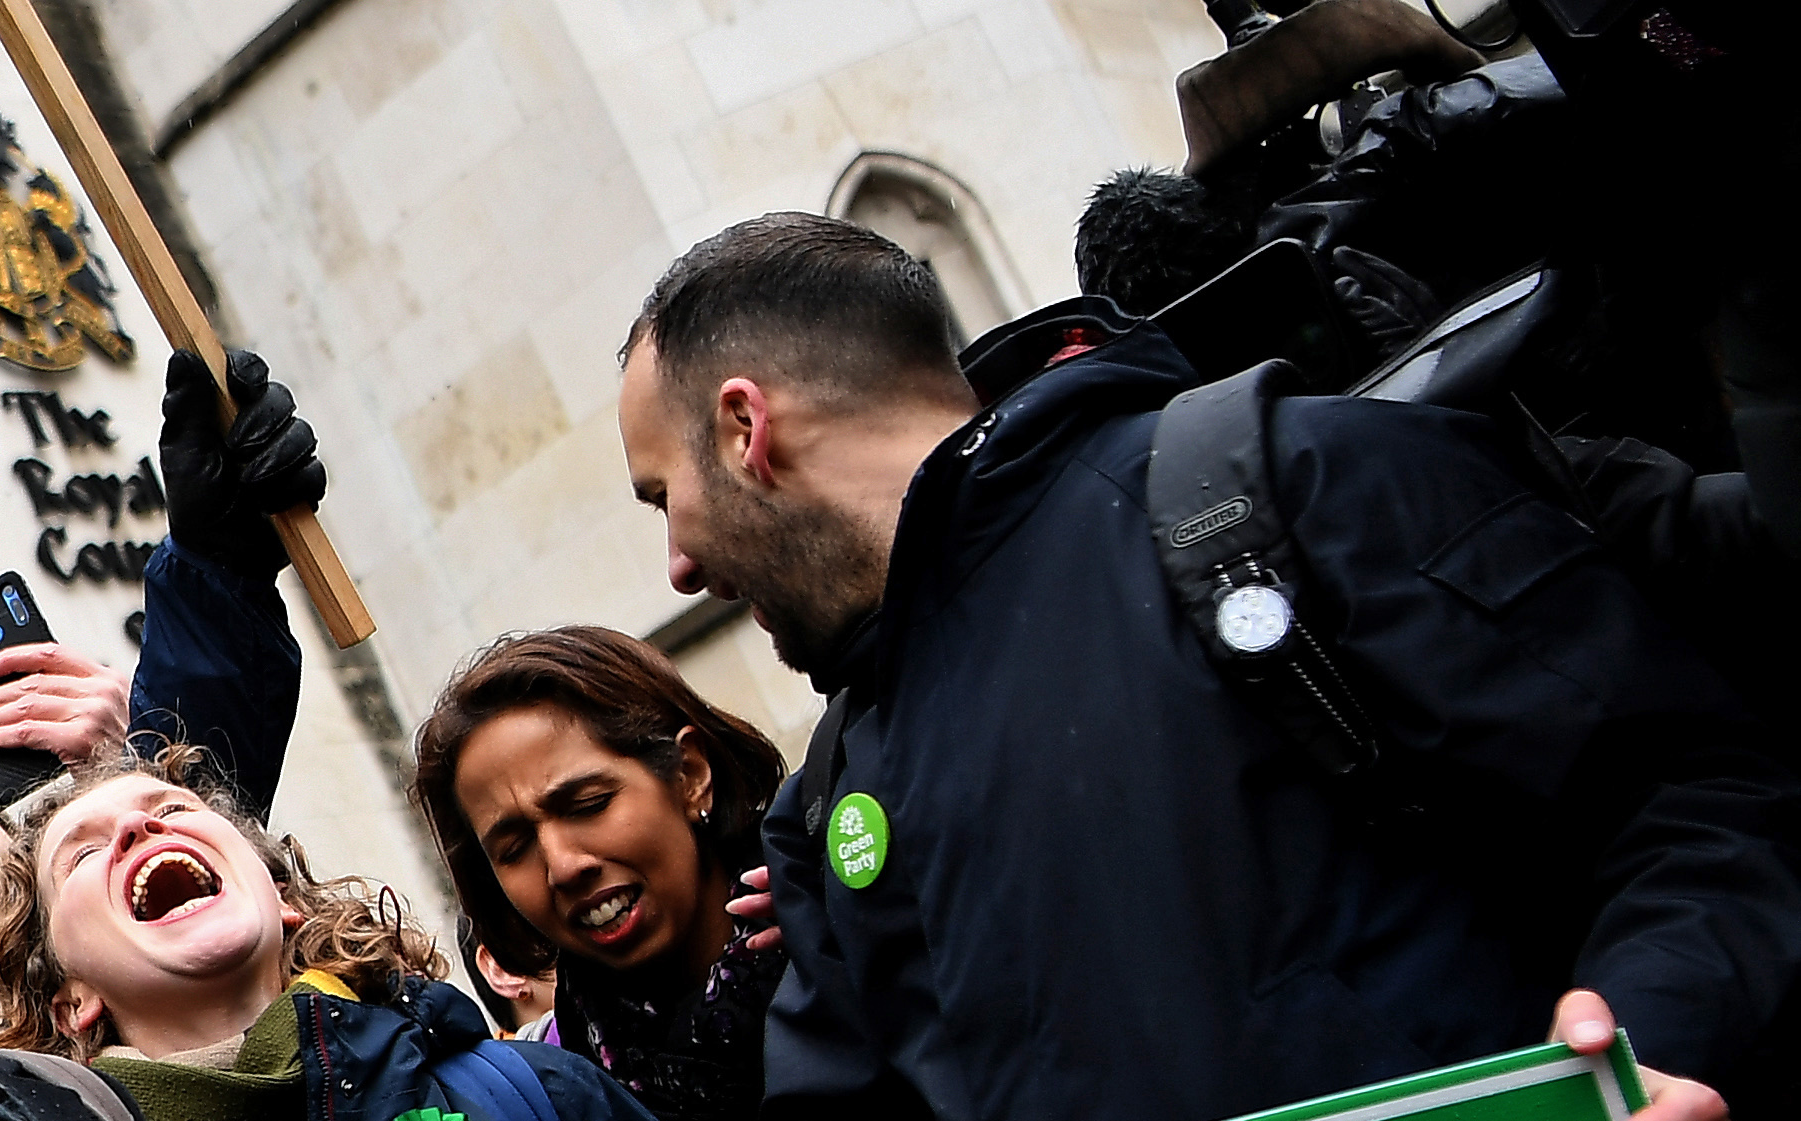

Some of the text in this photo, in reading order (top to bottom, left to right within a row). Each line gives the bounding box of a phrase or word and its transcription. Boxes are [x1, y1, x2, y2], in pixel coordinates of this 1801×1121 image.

[1, 391, 119, 448] The
[838, 833, 874, 860] Green
[843, 852, 876, 877] Party
